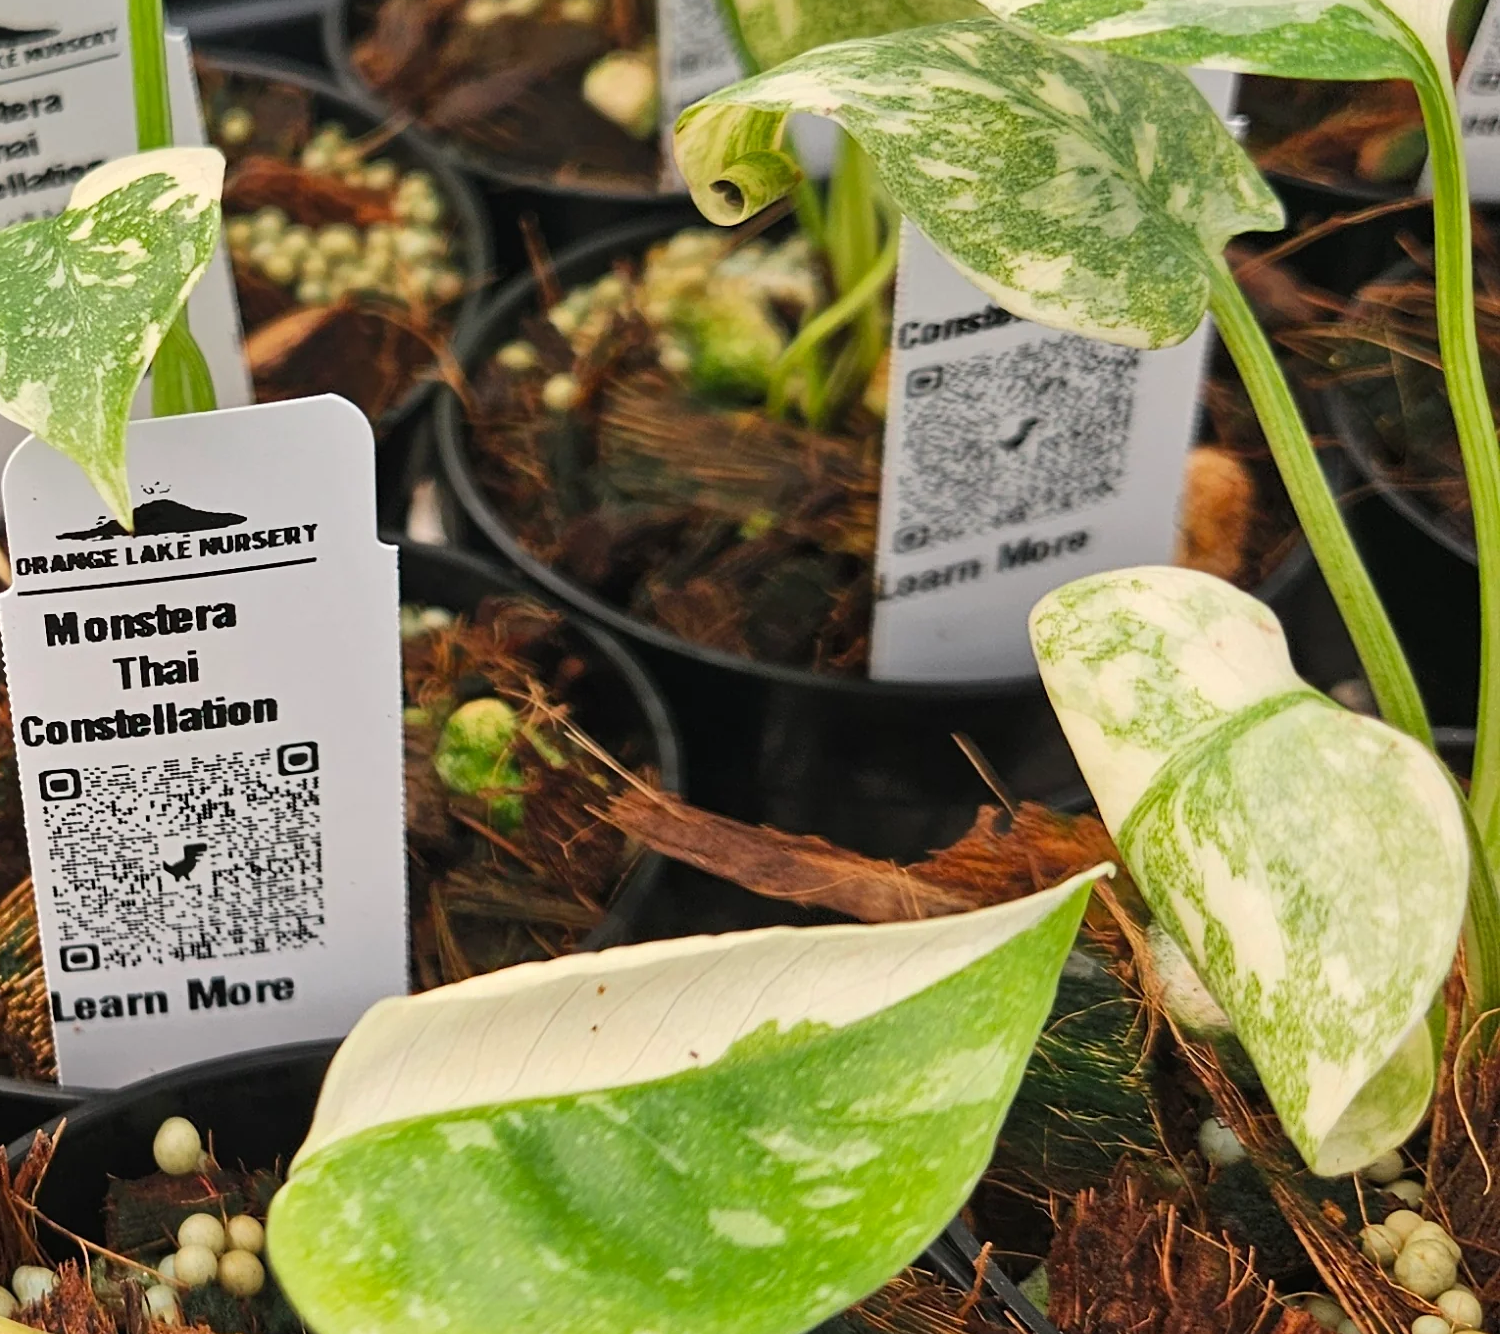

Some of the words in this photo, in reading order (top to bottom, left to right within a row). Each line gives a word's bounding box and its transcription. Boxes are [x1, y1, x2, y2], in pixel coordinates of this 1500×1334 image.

[24, 27, 118, 64] NURSERY
[15, 547, 119, 577] ORANGE
[125, 536, 191, 567] LAKE
[200, 523, 318, 557] NURSERY
[877, 556, 981, 601] Learn
[996, 528, 1090, 571] More
[43, 599, 238, 648] Monstera
[113, 650, 200, 691] Thai
[20, 692, 278, 747] Constellation
[52, 981, 168, 1023] Learn
[188, 973, 296, 1012] More
